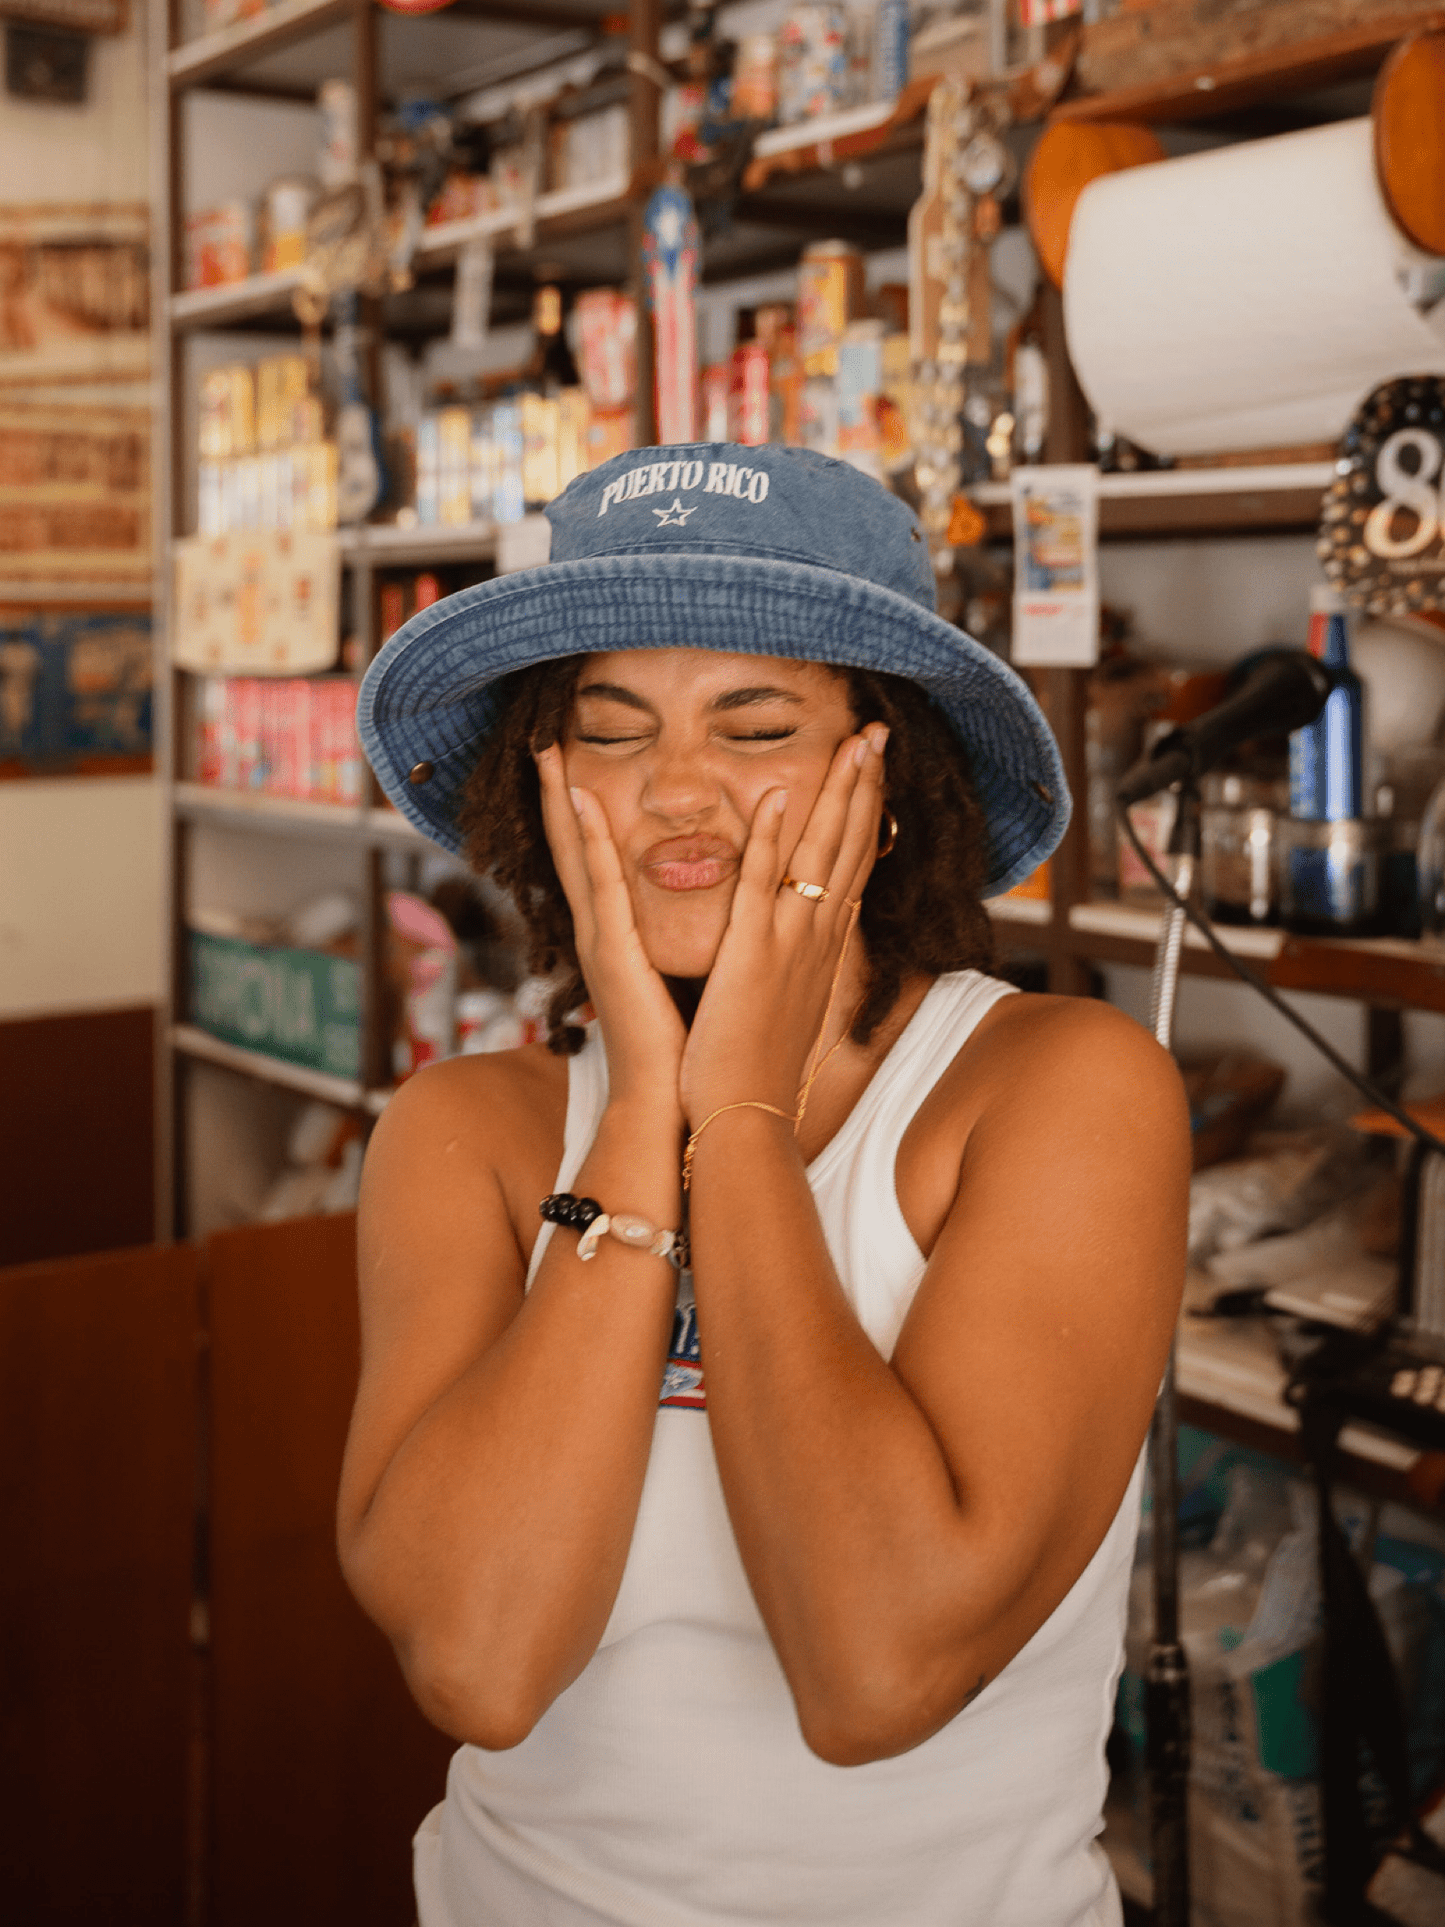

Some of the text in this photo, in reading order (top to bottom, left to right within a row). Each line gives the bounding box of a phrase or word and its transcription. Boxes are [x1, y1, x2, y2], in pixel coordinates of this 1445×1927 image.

[597, 460, 770, 518] PUERTO RICO
[1364, 428, 1445, 558] 8
